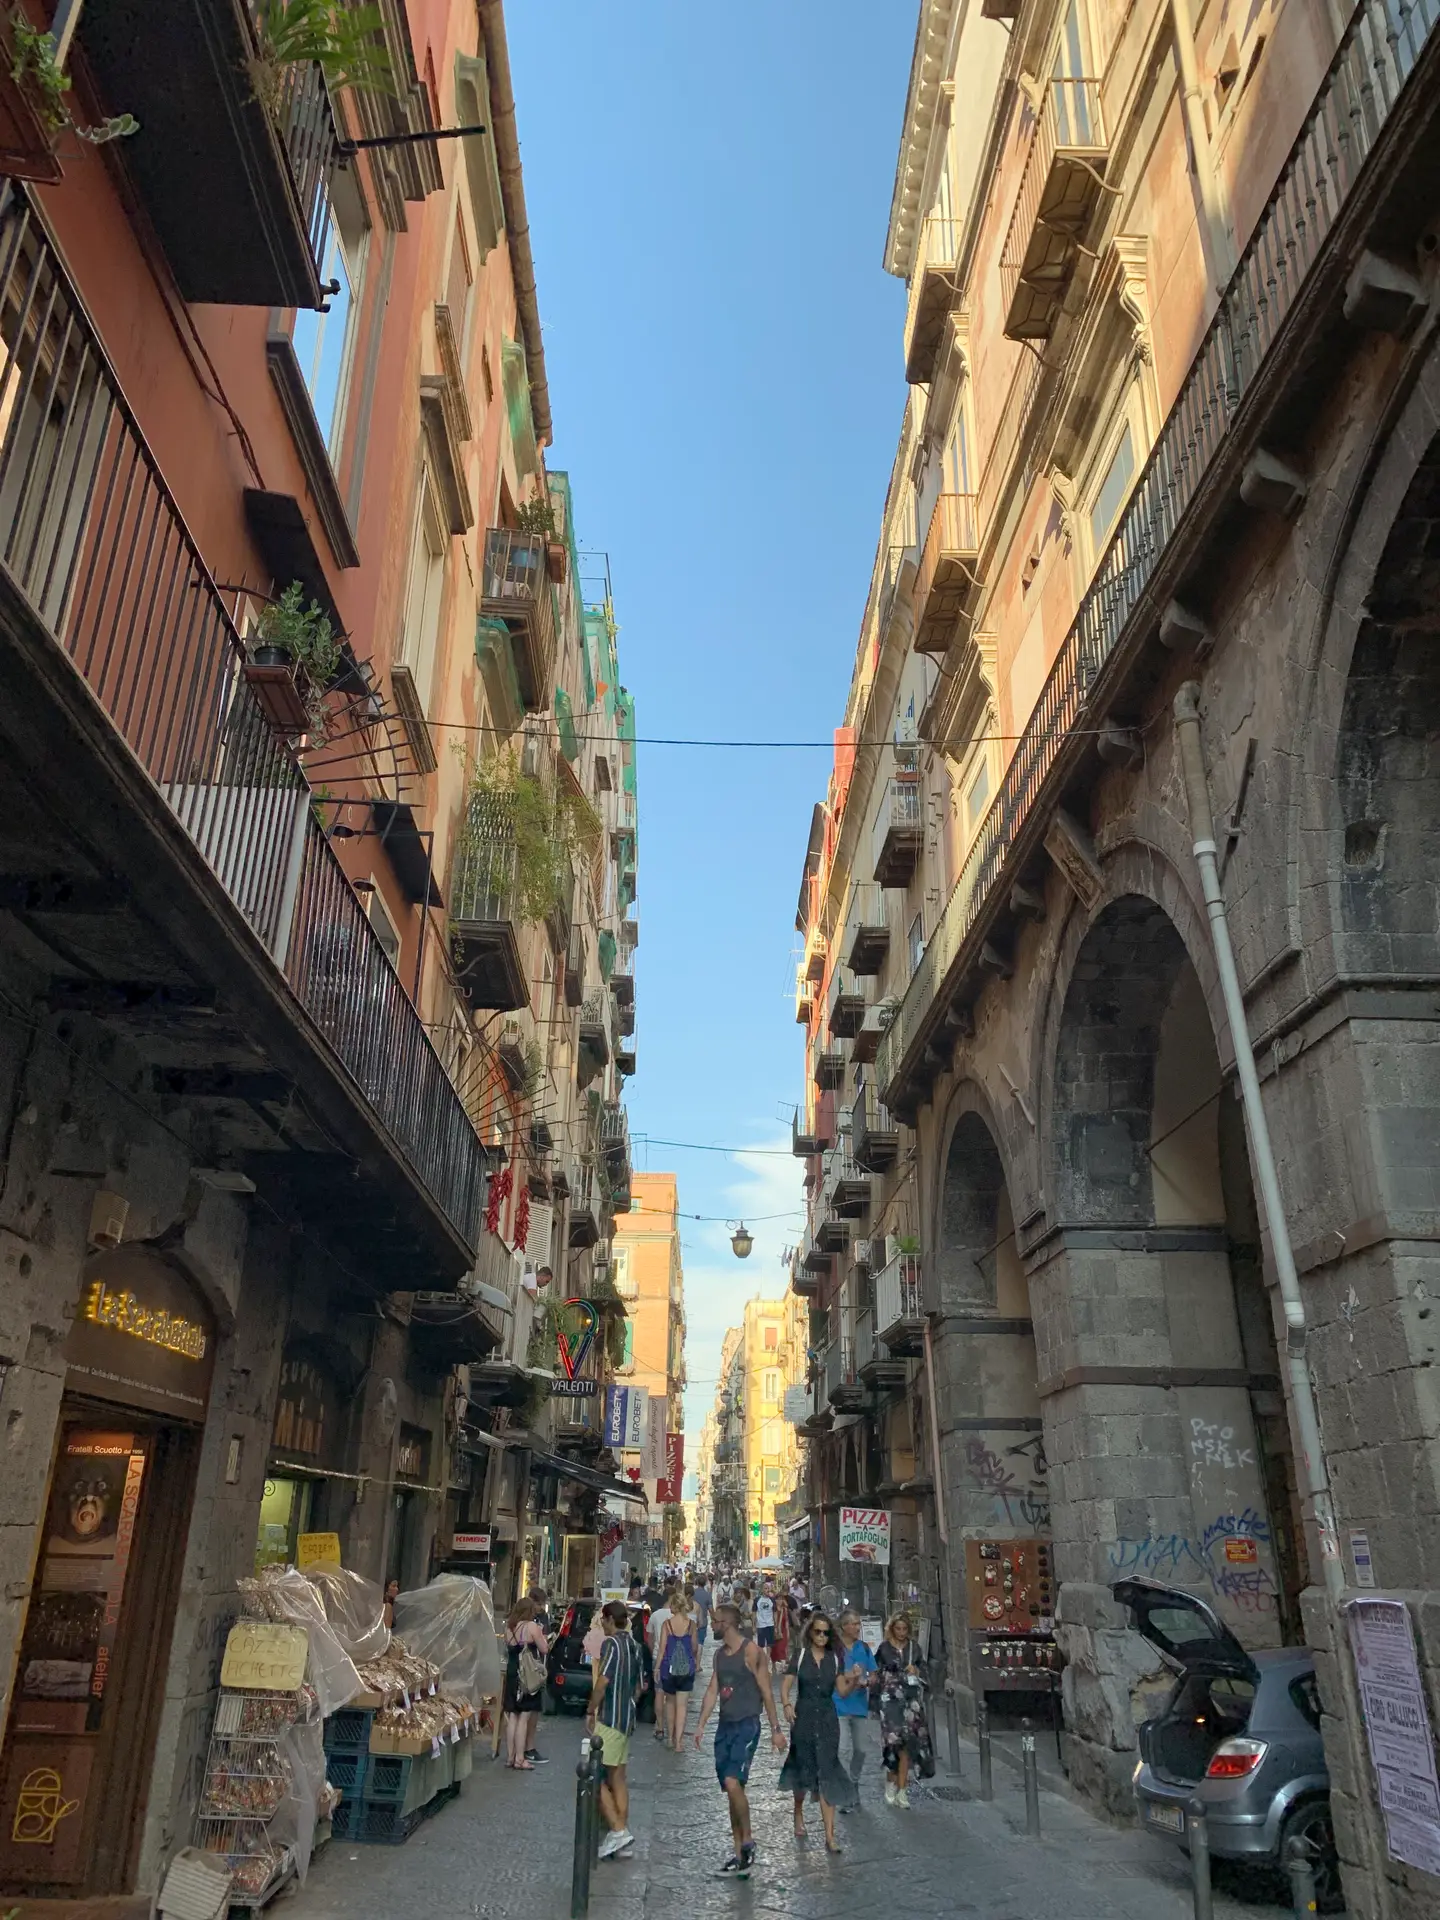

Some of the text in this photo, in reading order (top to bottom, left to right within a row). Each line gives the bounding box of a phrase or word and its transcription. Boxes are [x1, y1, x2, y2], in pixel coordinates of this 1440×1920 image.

[551, 1380, 594, 1393] VALENTI
[67, 1444, 93, 1453] Fratelli
[94, 1445, 123, 1454] Scuotto
[128, 1459, 143, 1481] LA
[663, 1437, 677, 1497] PIZZERIA
[842, 1509, 889, 1526] PIZZA
[455, 1536, 487, 1544] KIMBO
[842, 1532, 888, 1549] PORTAFOGLIO
[92, 1646, 109, 1698] atelier
